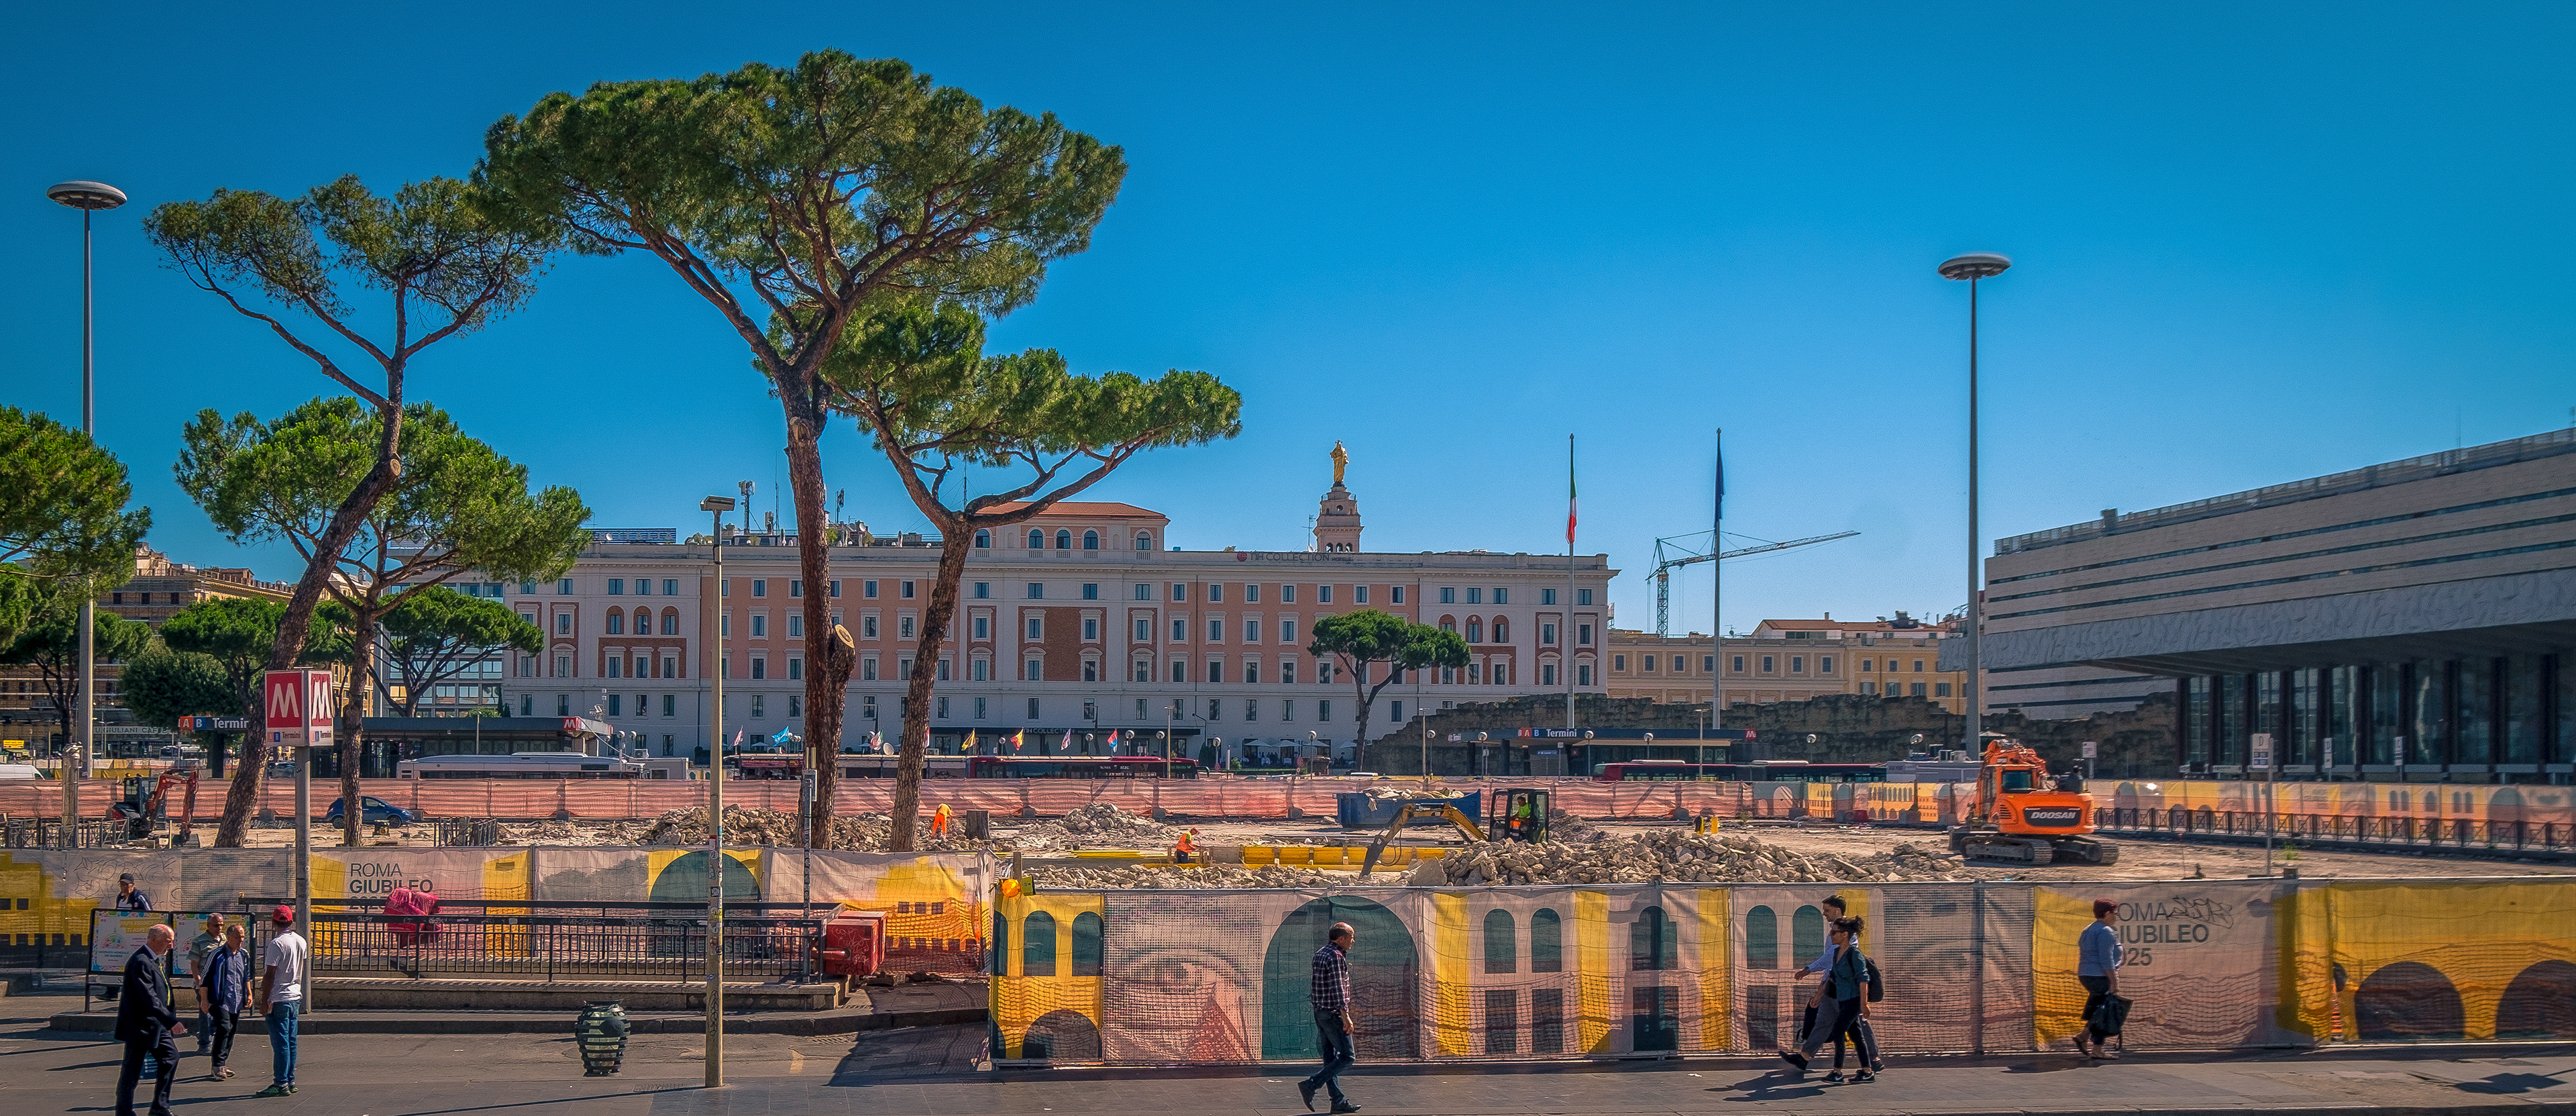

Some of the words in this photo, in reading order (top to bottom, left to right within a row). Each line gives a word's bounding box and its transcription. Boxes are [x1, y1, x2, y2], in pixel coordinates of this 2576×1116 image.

[1266, 552, 1330, 562] COLLECTION
[270, 682, 299, 718] M
[312, 680, 332, 719] M
[182, 719, 190, 727] A
[196, 719, 203, 727] B
[212, 717, 249, 728] Termi
[564, 719, 576, 728] M
[1546, 729, 1577, 738] Termini
[2259, 735, 2264, 746] D
[2031, 811, 2076, 819] DOOSAN
[350, 863, 402, 877] ROMA
[2117, 902, 2169, 921] OMA
